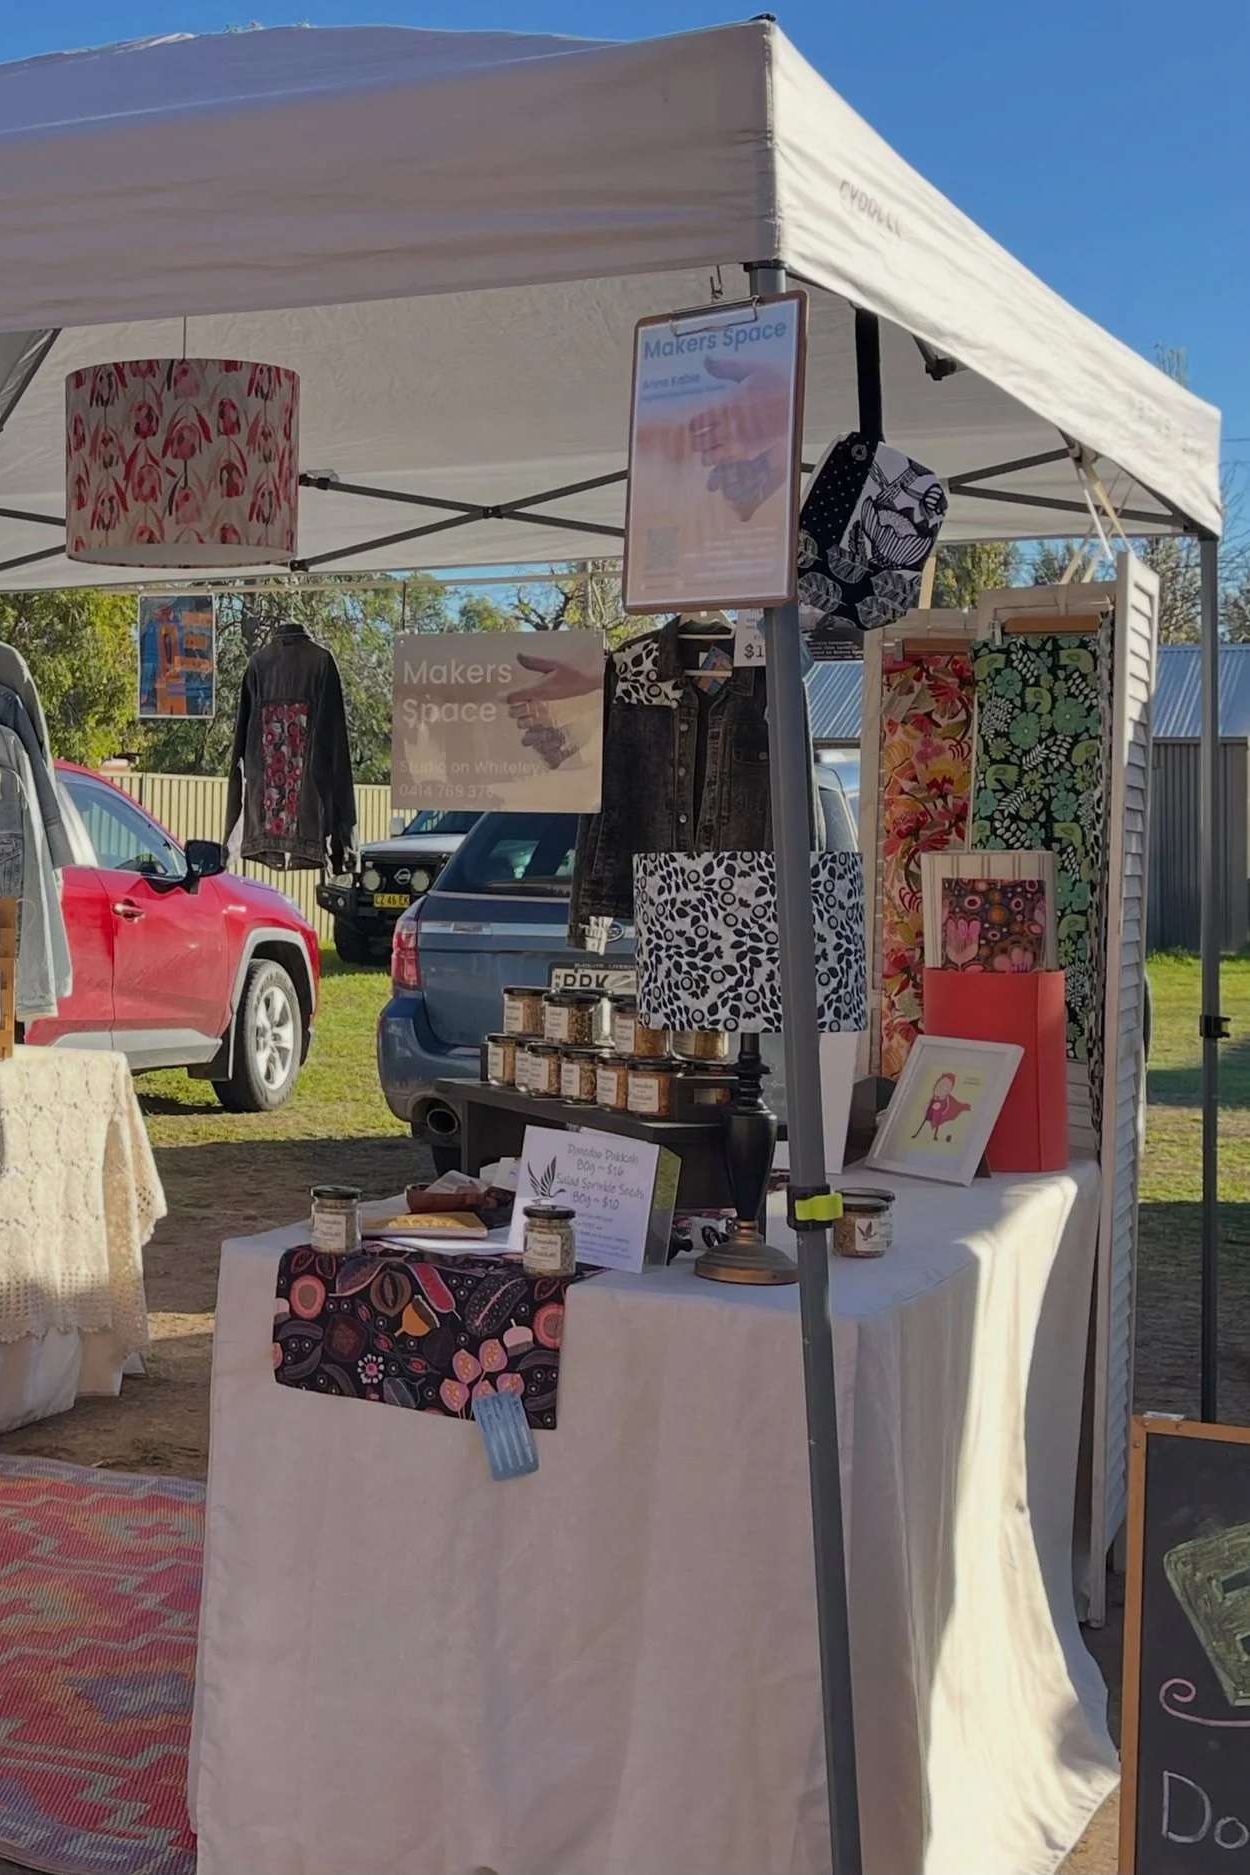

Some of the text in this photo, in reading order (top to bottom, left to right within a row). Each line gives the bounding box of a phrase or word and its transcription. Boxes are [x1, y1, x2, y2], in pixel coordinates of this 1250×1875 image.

[644, 321, 787, 359] Makers Space
[403, 659, 513, 685] Makers
[402, 698, 498, 724] Space
[451, 761, 470, 774] on
[400, 784, 433, 797] 0414
